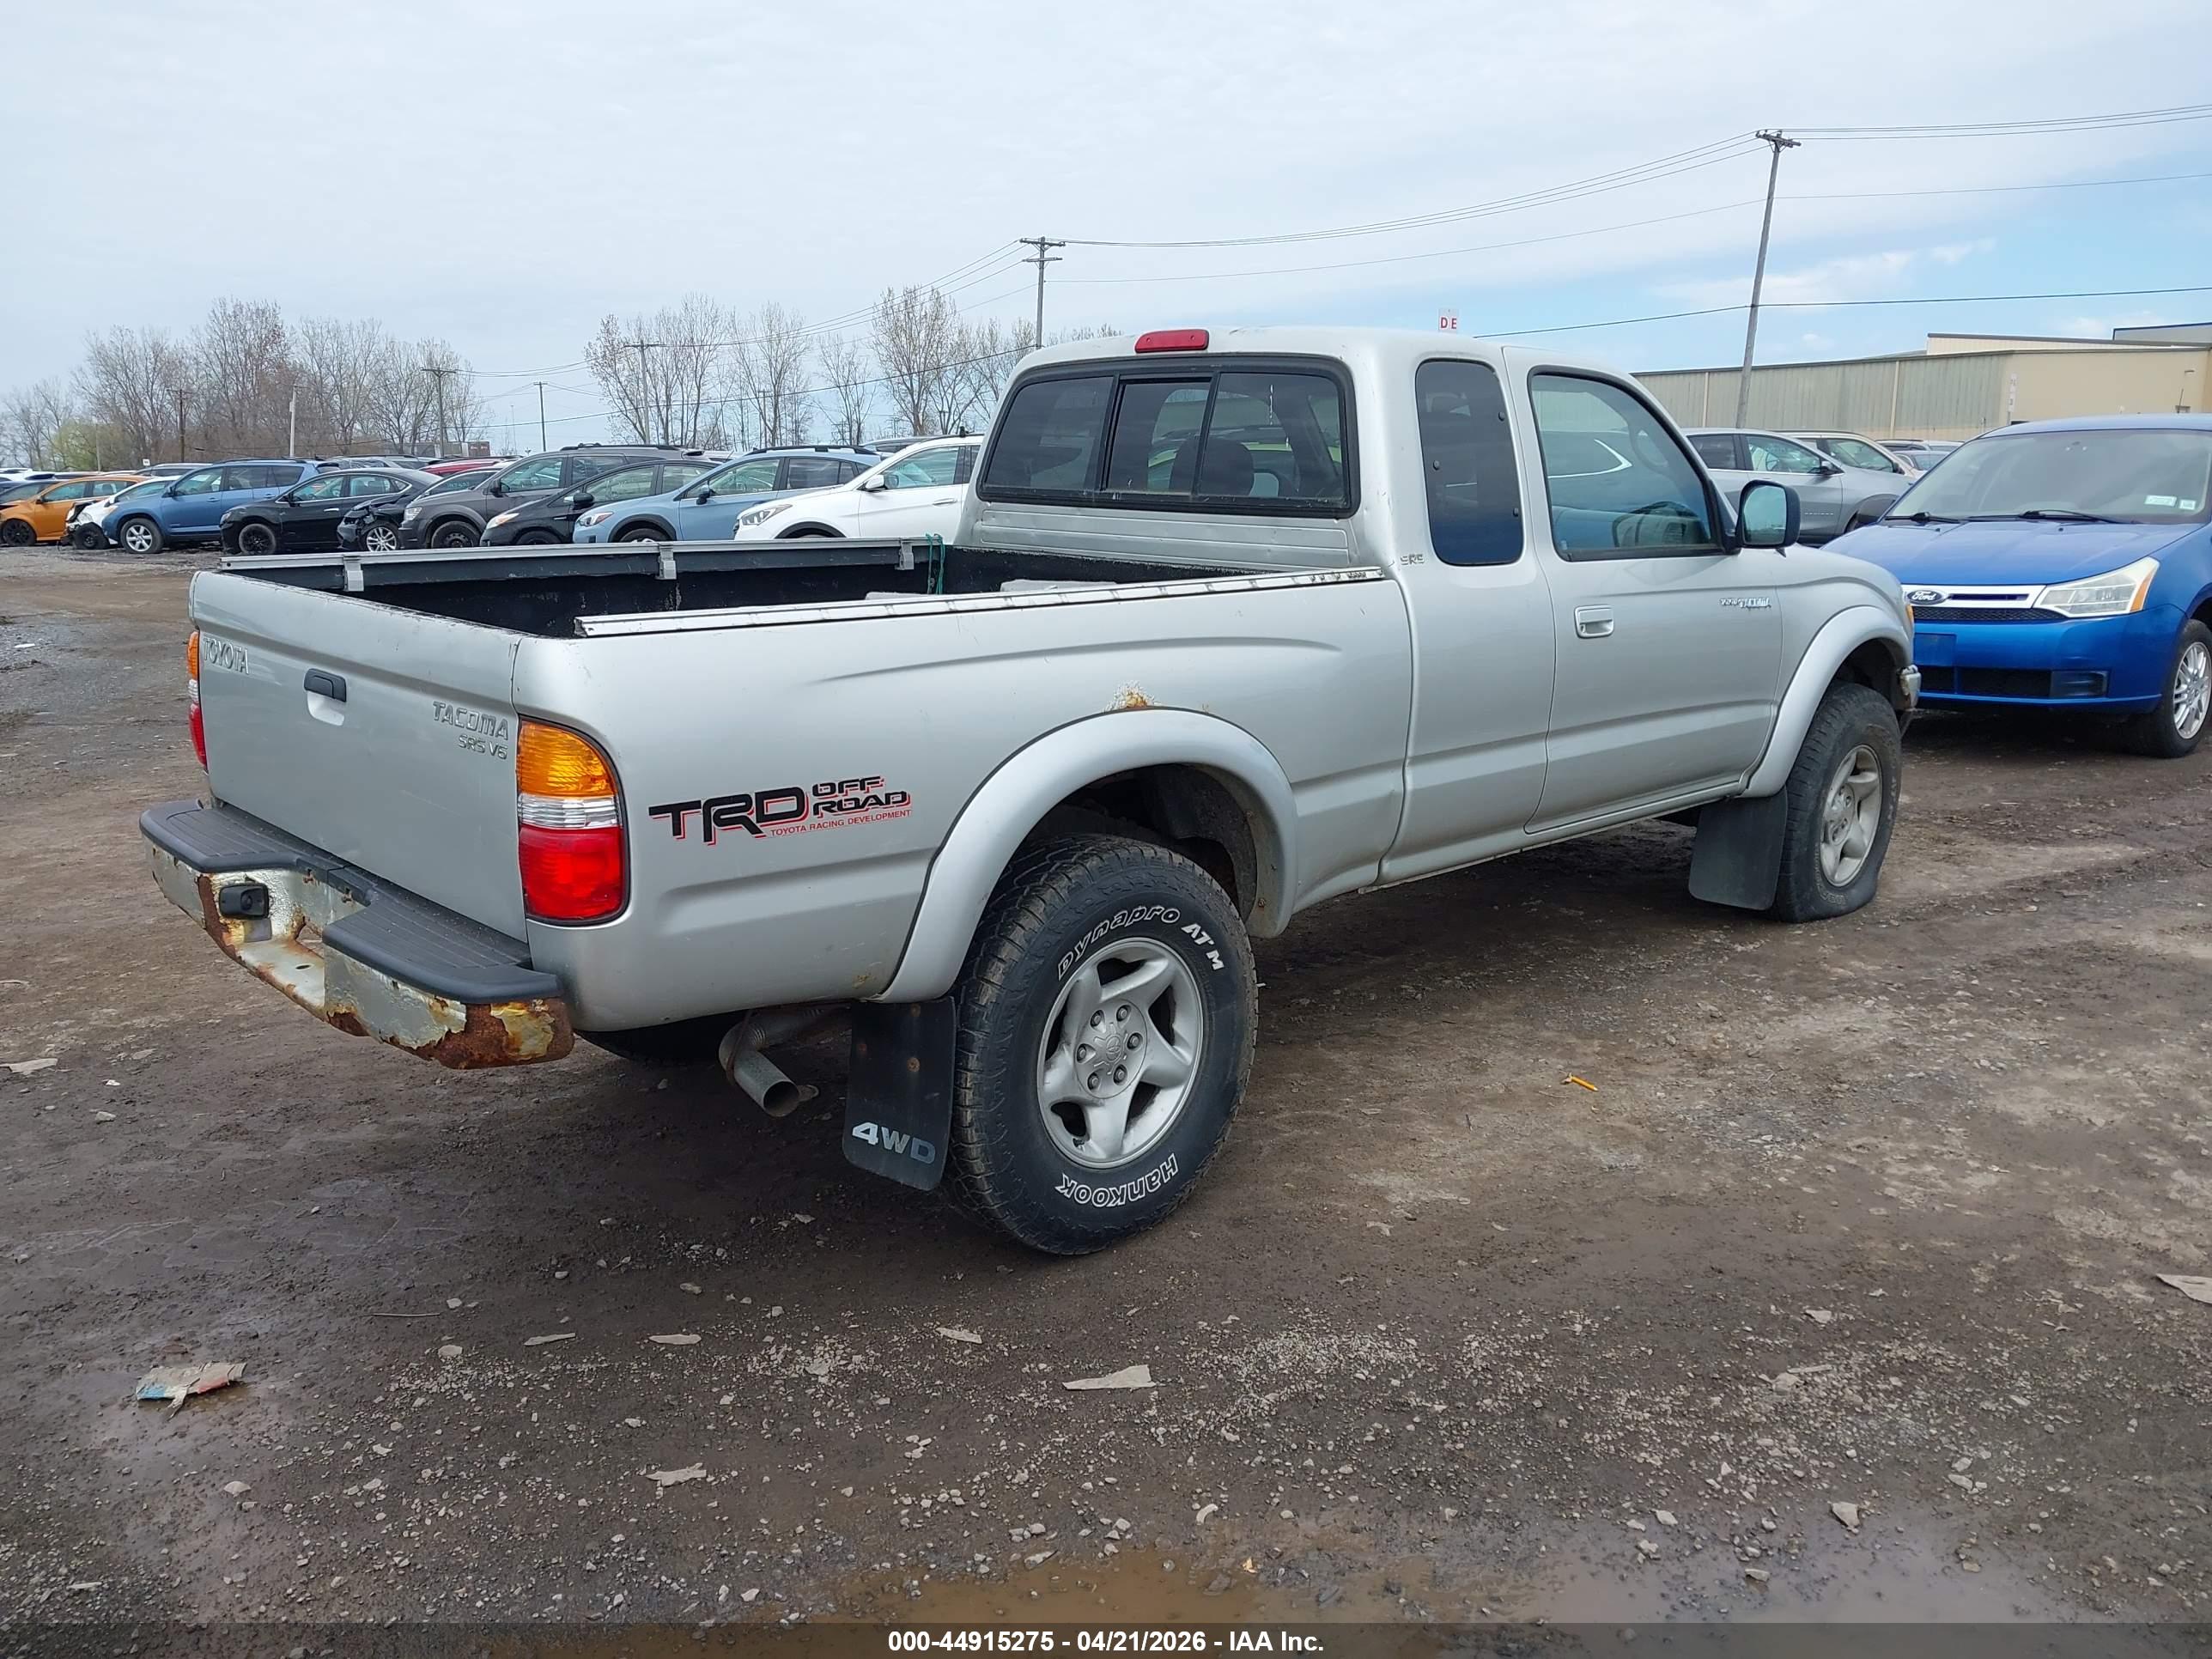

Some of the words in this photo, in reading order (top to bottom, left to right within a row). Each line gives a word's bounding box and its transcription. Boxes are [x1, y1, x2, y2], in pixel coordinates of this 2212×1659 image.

[203, 636, 249, 675] TOYOTA
[433, 701, 508, 740] TACOMA
[458, 734, 486, 754] SR5
[489, 741, 508, 760] V6
[811, 775, 884, 799] OFF
[648, 786, 809, 846] TRD
[812, 790, 911, 819] ROAD
[770, 824, 807, 837] TOYOTA
[809, 818, 845, 831] RACING
[848, 809, 911, 826] DEVELOPMENT
[852, 1121, 936, 1164] 4WD
